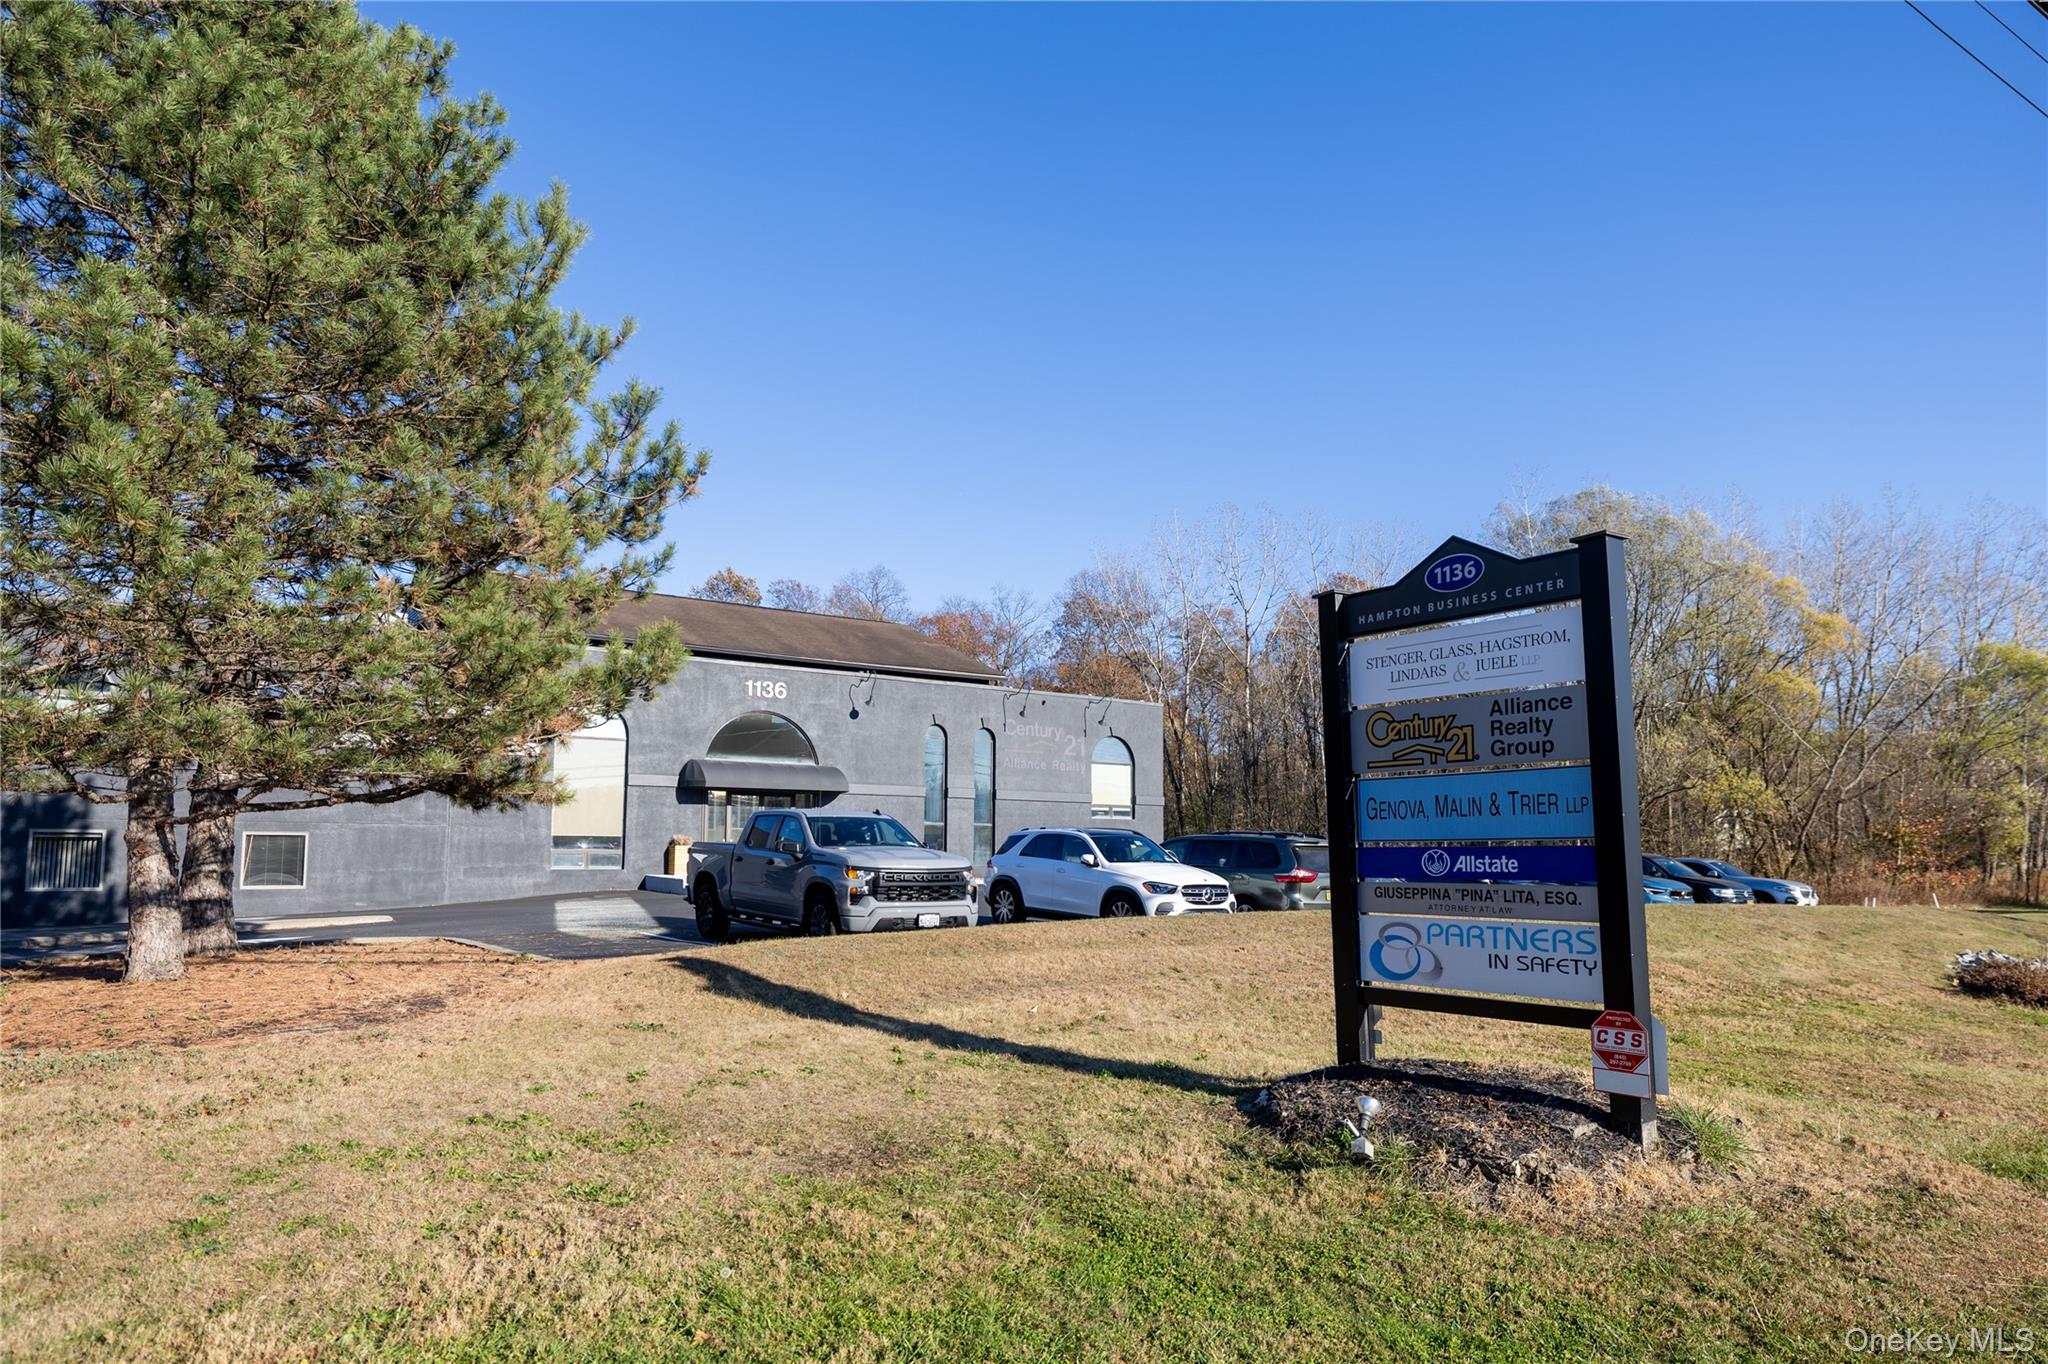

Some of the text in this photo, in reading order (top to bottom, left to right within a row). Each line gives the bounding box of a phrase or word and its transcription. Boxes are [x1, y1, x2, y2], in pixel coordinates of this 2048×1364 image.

[1434, 560, 1476, 585] 1136
[1358, 578, 1565, 625] HAMPTON BUSINESS CENTER
[1366, 629, 1571, 670] STENGER, GLASS, HAGSTROM,
[1390, 655, 1541, 683] LINDARS & IUELE LLP
[744, 679, 788, 699] 1136
[1489, 695, 1573, 717] Alliance
[1006, 719, 1087, 757] Century 21
[1366, 710, 1457, 748] Century
[1490, 716, 1554, 737] Realty
[1446, 725, 1475, 764] 21
[1490, 739, 1555, 758] Group
[1003, 758, 1087, 774] Alliance Realty
[1366, 791, 1589, 822] GENOVA, MALIN & TRIER LLP
[1453, 855, 1519, 873] Allstate
[1374, 886, 1582, 907] GIUSEPPINA "PINA" LITA, ESQ.
[1428, 904, 1513, 915] ATTORNEY AT LAW
[1426, 923, 1598, 955] PARTNERS
[1488, 953, 1598, 976] IN SAFETY
